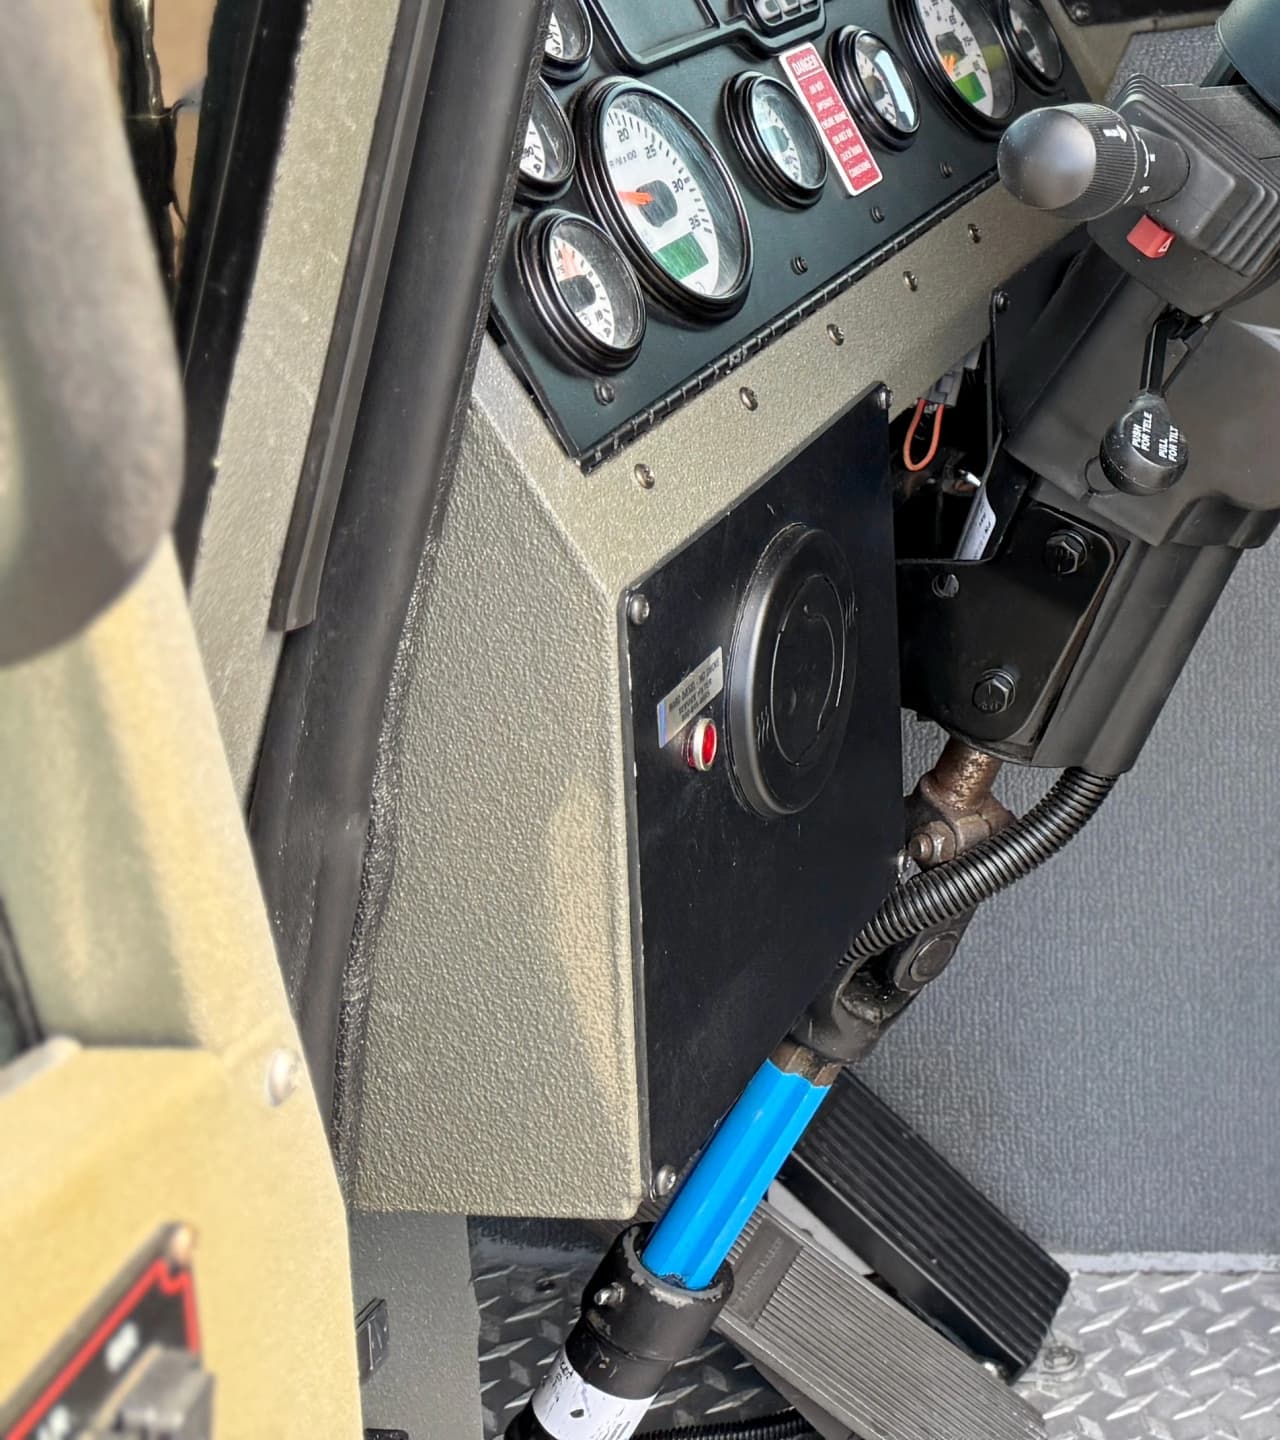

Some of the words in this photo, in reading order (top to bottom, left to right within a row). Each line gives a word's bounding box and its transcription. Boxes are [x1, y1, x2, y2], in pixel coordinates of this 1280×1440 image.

[790, 54, 820, 76] DANGER
[616, 128, 630, 143] 20
[645, 144, 657, 160] 25
[672, 178, 685, 194] 30
[688, 215, 701, 230] 35
[1142, 411, 1153, 433] TELE
[1132, 423, 1142, 448] PUSH
[1141, 433, 1151, 452] FOR
[1169, 425, 1179, 443] TILT
[1158, 438, 1168, 458] PULL
[1168, 443, 1178, 462] FOR
